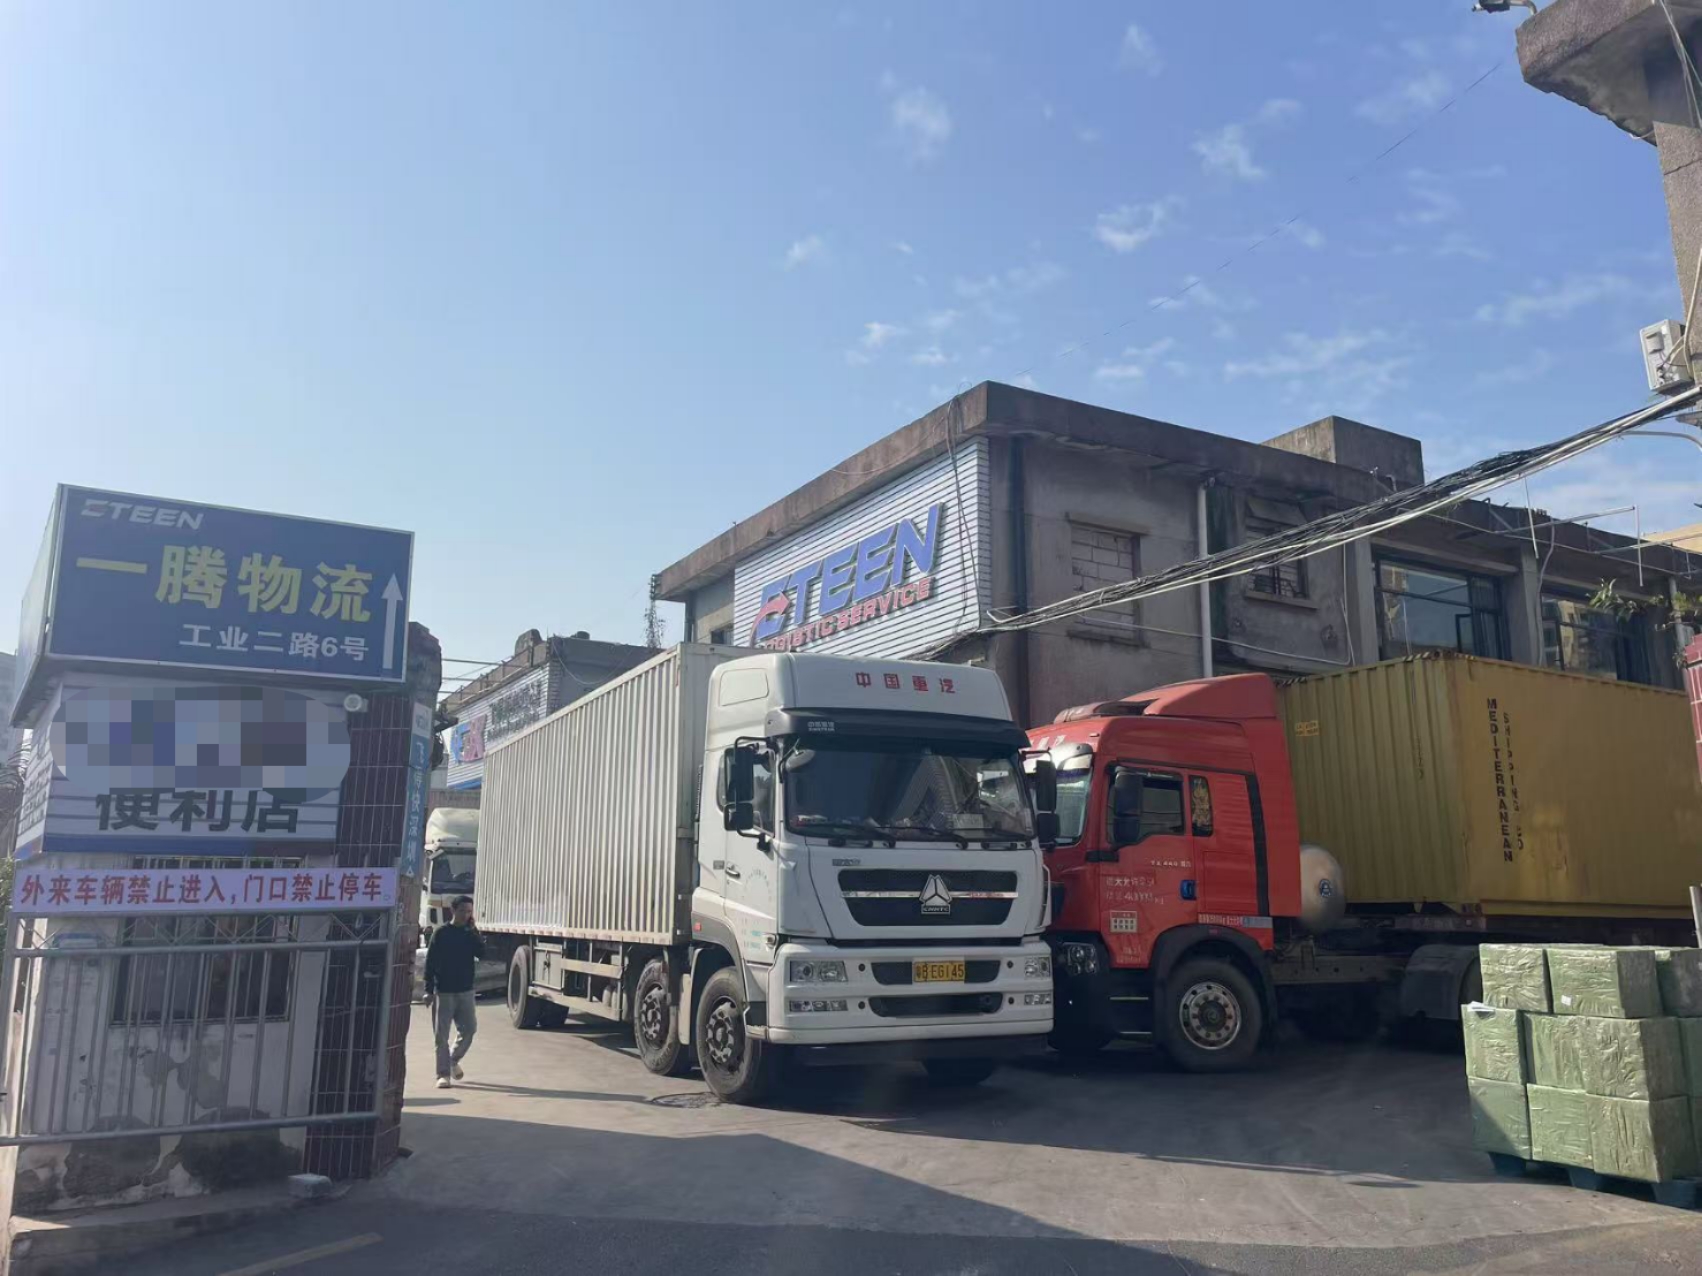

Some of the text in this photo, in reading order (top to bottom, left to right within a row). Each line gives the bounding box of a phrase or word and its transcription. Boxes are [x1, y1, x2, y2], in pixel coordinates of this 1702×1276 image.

[81, 499, 204, 530] ETEEN
[76, 545, 373, 622] 一腾物流
[756, 502, 944, 640] ETEEN
[837, 577, 932, 626] SERVICE
[179, 624, 369, 662] 工业二路6号
[855, 672, 956, 694] 中国重汽
[1487, 698, 1514, 862] MEDITERRANEAN
